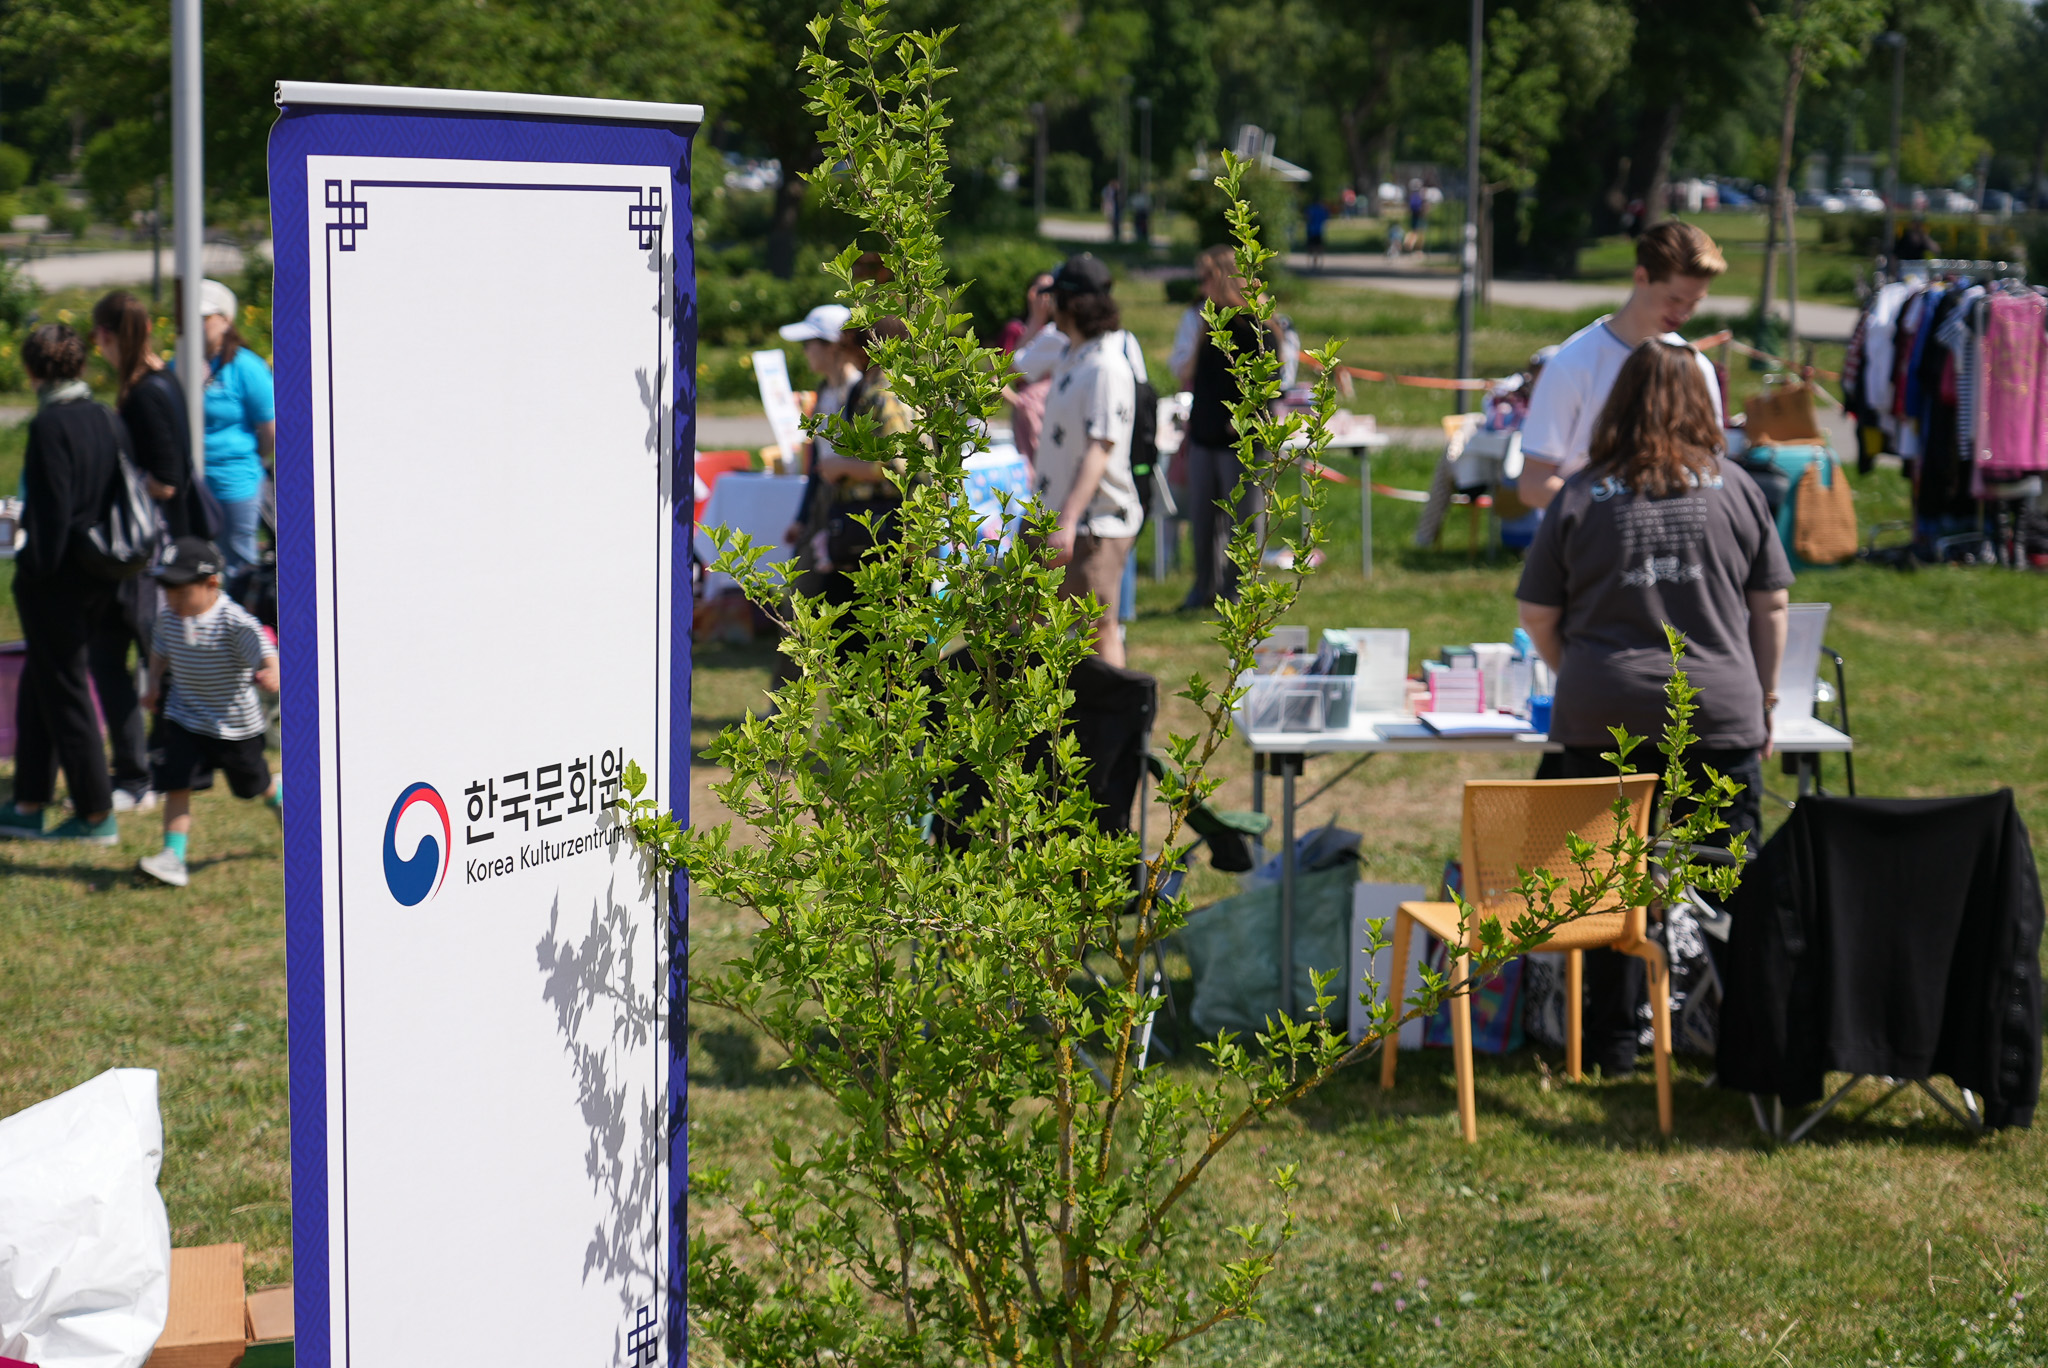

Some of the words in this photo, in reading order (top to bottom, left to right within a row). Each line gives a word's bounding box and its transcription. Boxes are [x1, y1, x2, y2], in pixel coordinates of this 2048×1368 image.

[464, 747, 624, 845] 한국문화원
[466, 855, 514, 885] Korea
[520, 824, 625, 870] Kulturzentrum
